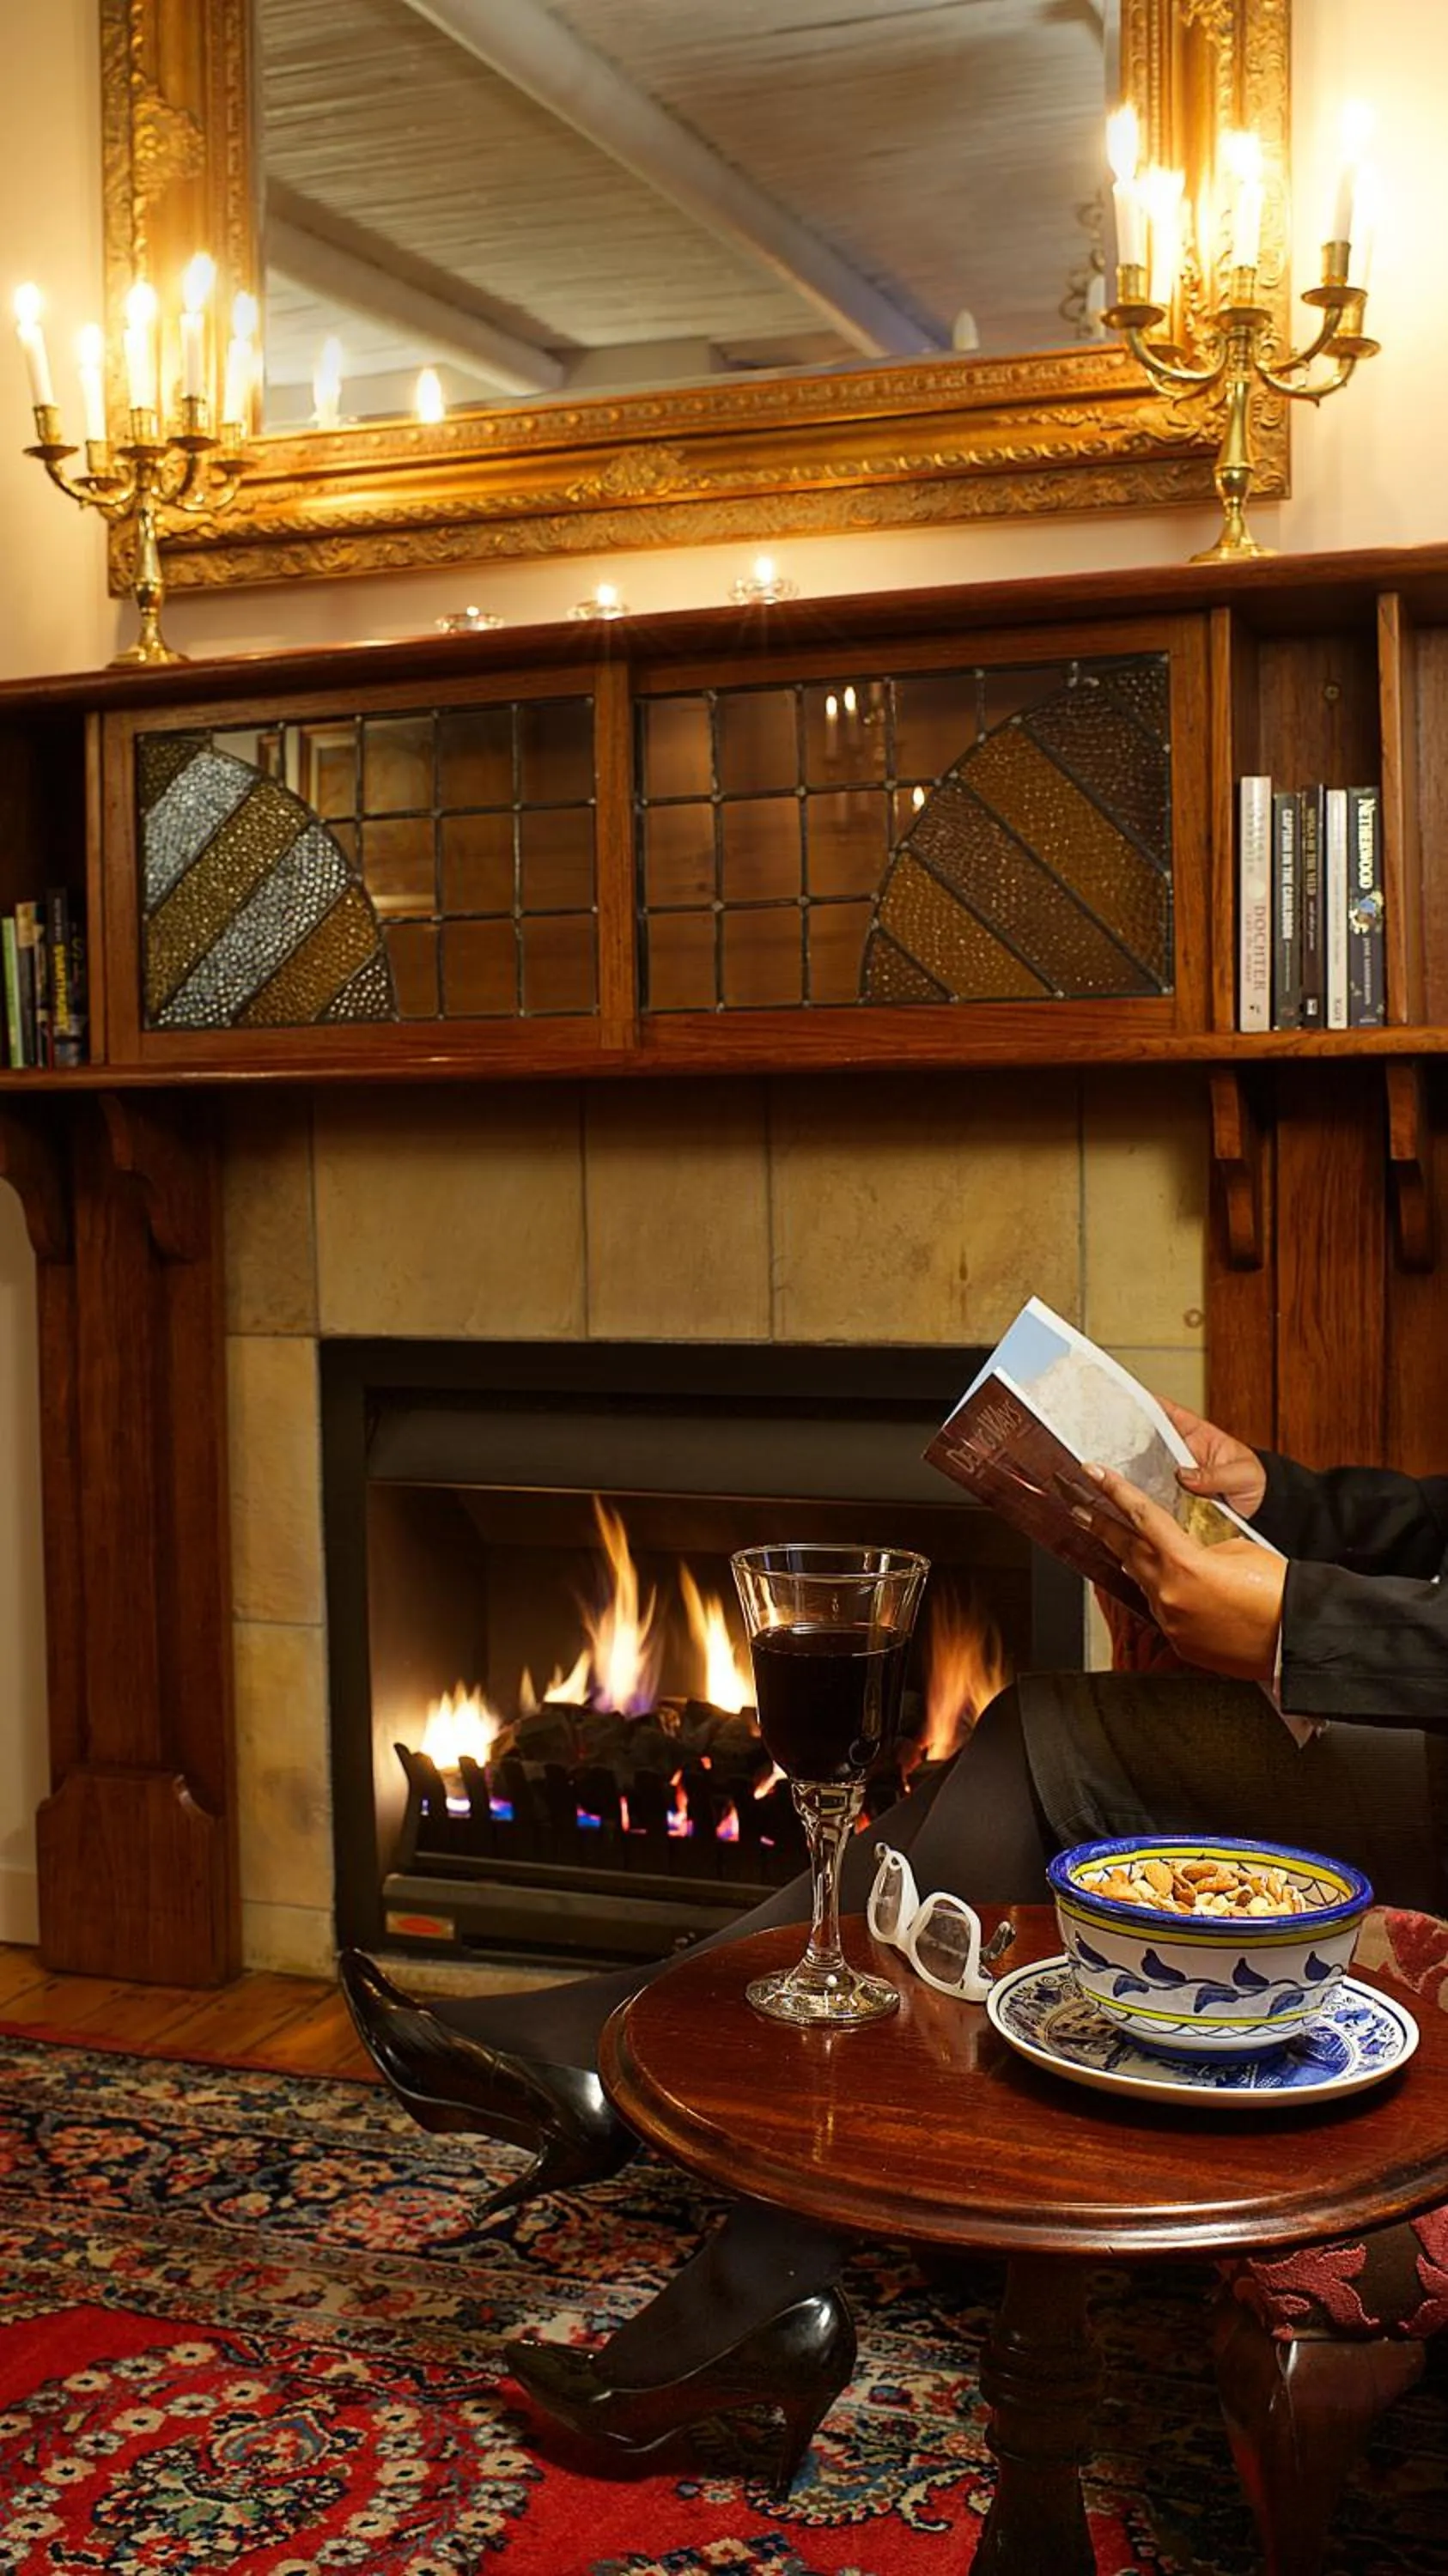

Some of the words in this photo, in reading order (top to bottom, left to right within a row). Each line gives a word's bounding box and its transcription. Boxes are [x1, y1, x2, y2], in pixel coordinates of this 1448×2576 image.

[1281, 809, 1293, 852] CAPTAIN
[1358, 798, 1376, 889] NETHERWOOD
[1281, 853, 1293, 866] IN
[1281, 867, 1293, 884] THE
[1282, 886, 1293, 939] CAULDRON
[1254, 905, 1266, 990] DOCHTER
